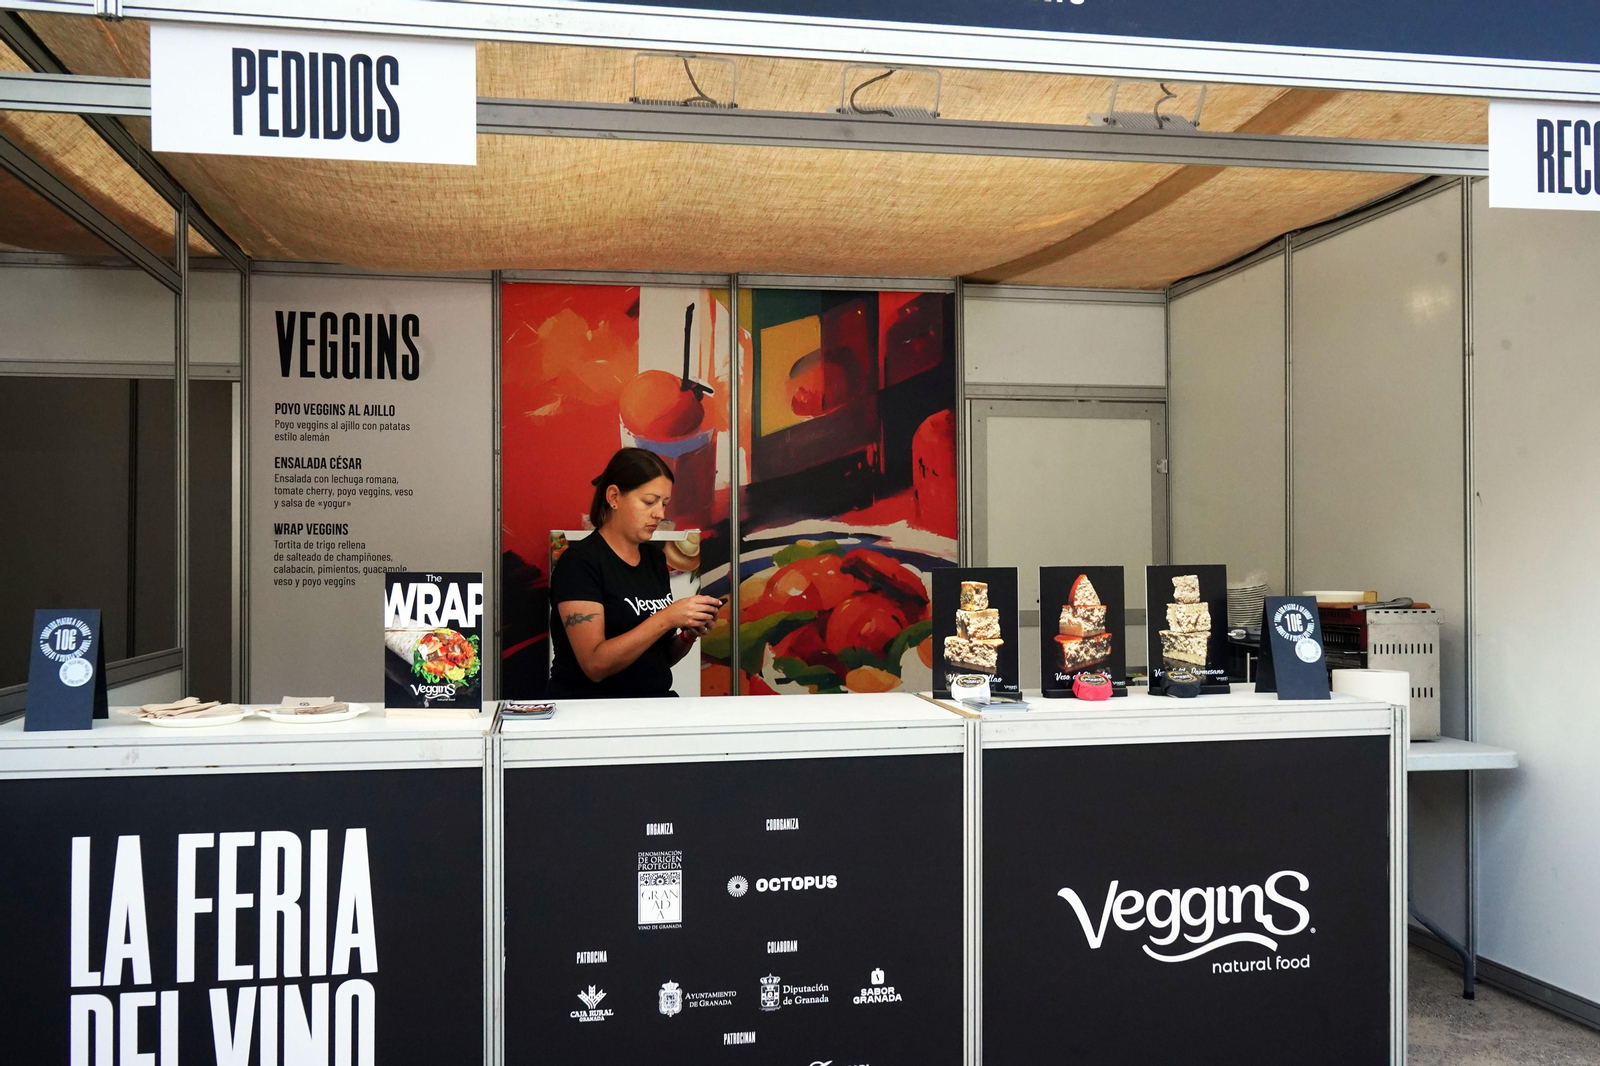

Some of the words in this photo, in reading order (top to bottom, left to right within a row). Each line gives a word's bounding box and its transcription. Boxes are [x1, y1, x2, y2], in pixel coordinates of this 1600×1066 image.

[232, 48, 399, 143] PEDIDOS
[275, 311, 419, 381] VEGGINS
[275, 403, 300, 415] POYO
[304, 403, 345, 415] VEGGINS
[349, 404, 360, 416] AL
[364, 405, 395, 416] AJILLO
[275, 420, 294, 431] Poyo
[297, 421, 328, 431] veggins
[331, 421, 338, 429] al
[341, 421, 359, 432] ajillo
[380, 423, 410, 432] patatas
[275, 432, 297, 441] estilo
[300, 433, 329, 441] alemán
[275, 457, 327, 469] ENSALADA
[330, 456, 361, 469] CÉSAR
[275, 474, 311, 483] Ensalada
[332, 475, 363, 485] lechuga
[275, 487, 303, 495] tomate
[306, 487, 334, 497] cherry,
[338, 489, 356, 497] poyo
[359, 487, 392, 498] veggins,
[274, 501, 278, 509] y
[281, 499, 302, 507] salsa
[305, 499, 315, 507] de
[318, 501, 351, 509] «yogur»
[274, 523, 303, 535] WRAP
[306, 523, 348, 535] VEGGINS
[274, 540, 301, 549] Tortita
[304, 540, 313, 549] de
[317, 540, 335, 551] trigo
[338, 541, 365, 549] rellena
[274, 553, 283, 561] de
[287, 553, 321, 561] salteado
[324, 553, 334, 561] de
[337, 553, 392, 563] champiñones,
[274, 565, 315, 573] calabacín,
[318, 565, 360, 575] pimientos,
[295, 579, 299, 587] y
[303, 579, 321, 587] poyo
[324, 577, 355, 588] veggins
[426, 574, 444, 583] The
[385, 583, 482, 628] WRAP
[1284, 614, 1304, 632] 10€
[54, 629, 77, 650] 10€
[410, 683, 456, 697] Veggins
[647, 823, 673, 835] ORGANIZA
[766, 818, 799, 830] COORGANIZA
[756, 875, 837, 892] OCTOPUS
[71, 835, 152, 987] LA
[177, 828, 378, 985] FERIA
[1057, 870, 1310, 949] Veggins
[768, 940, 797, 953] COLABORAN
[577, 951, 607, 964] PATROCINA
[1213, 957, 1271, 973] natural
[1276, 955, 1309, 969] food
[684, 990, 737, 1000] AYUNTAMIENTO
[783, 984, 828, 996] Diputación
[860, 986, 896, 996] SABOR
[699, 999, 732, 1007] GRANADA
[783, 997, 792, 1005] de
[794, 993, 828, 1004] Granada
[852, 994, 903, 1005] GRANADA
[570, 1010, 588, 1018] CAJA
[588, 1008, 614, 1017] RURAL
[724, 1032, 755, 1045] PATROCINAN
